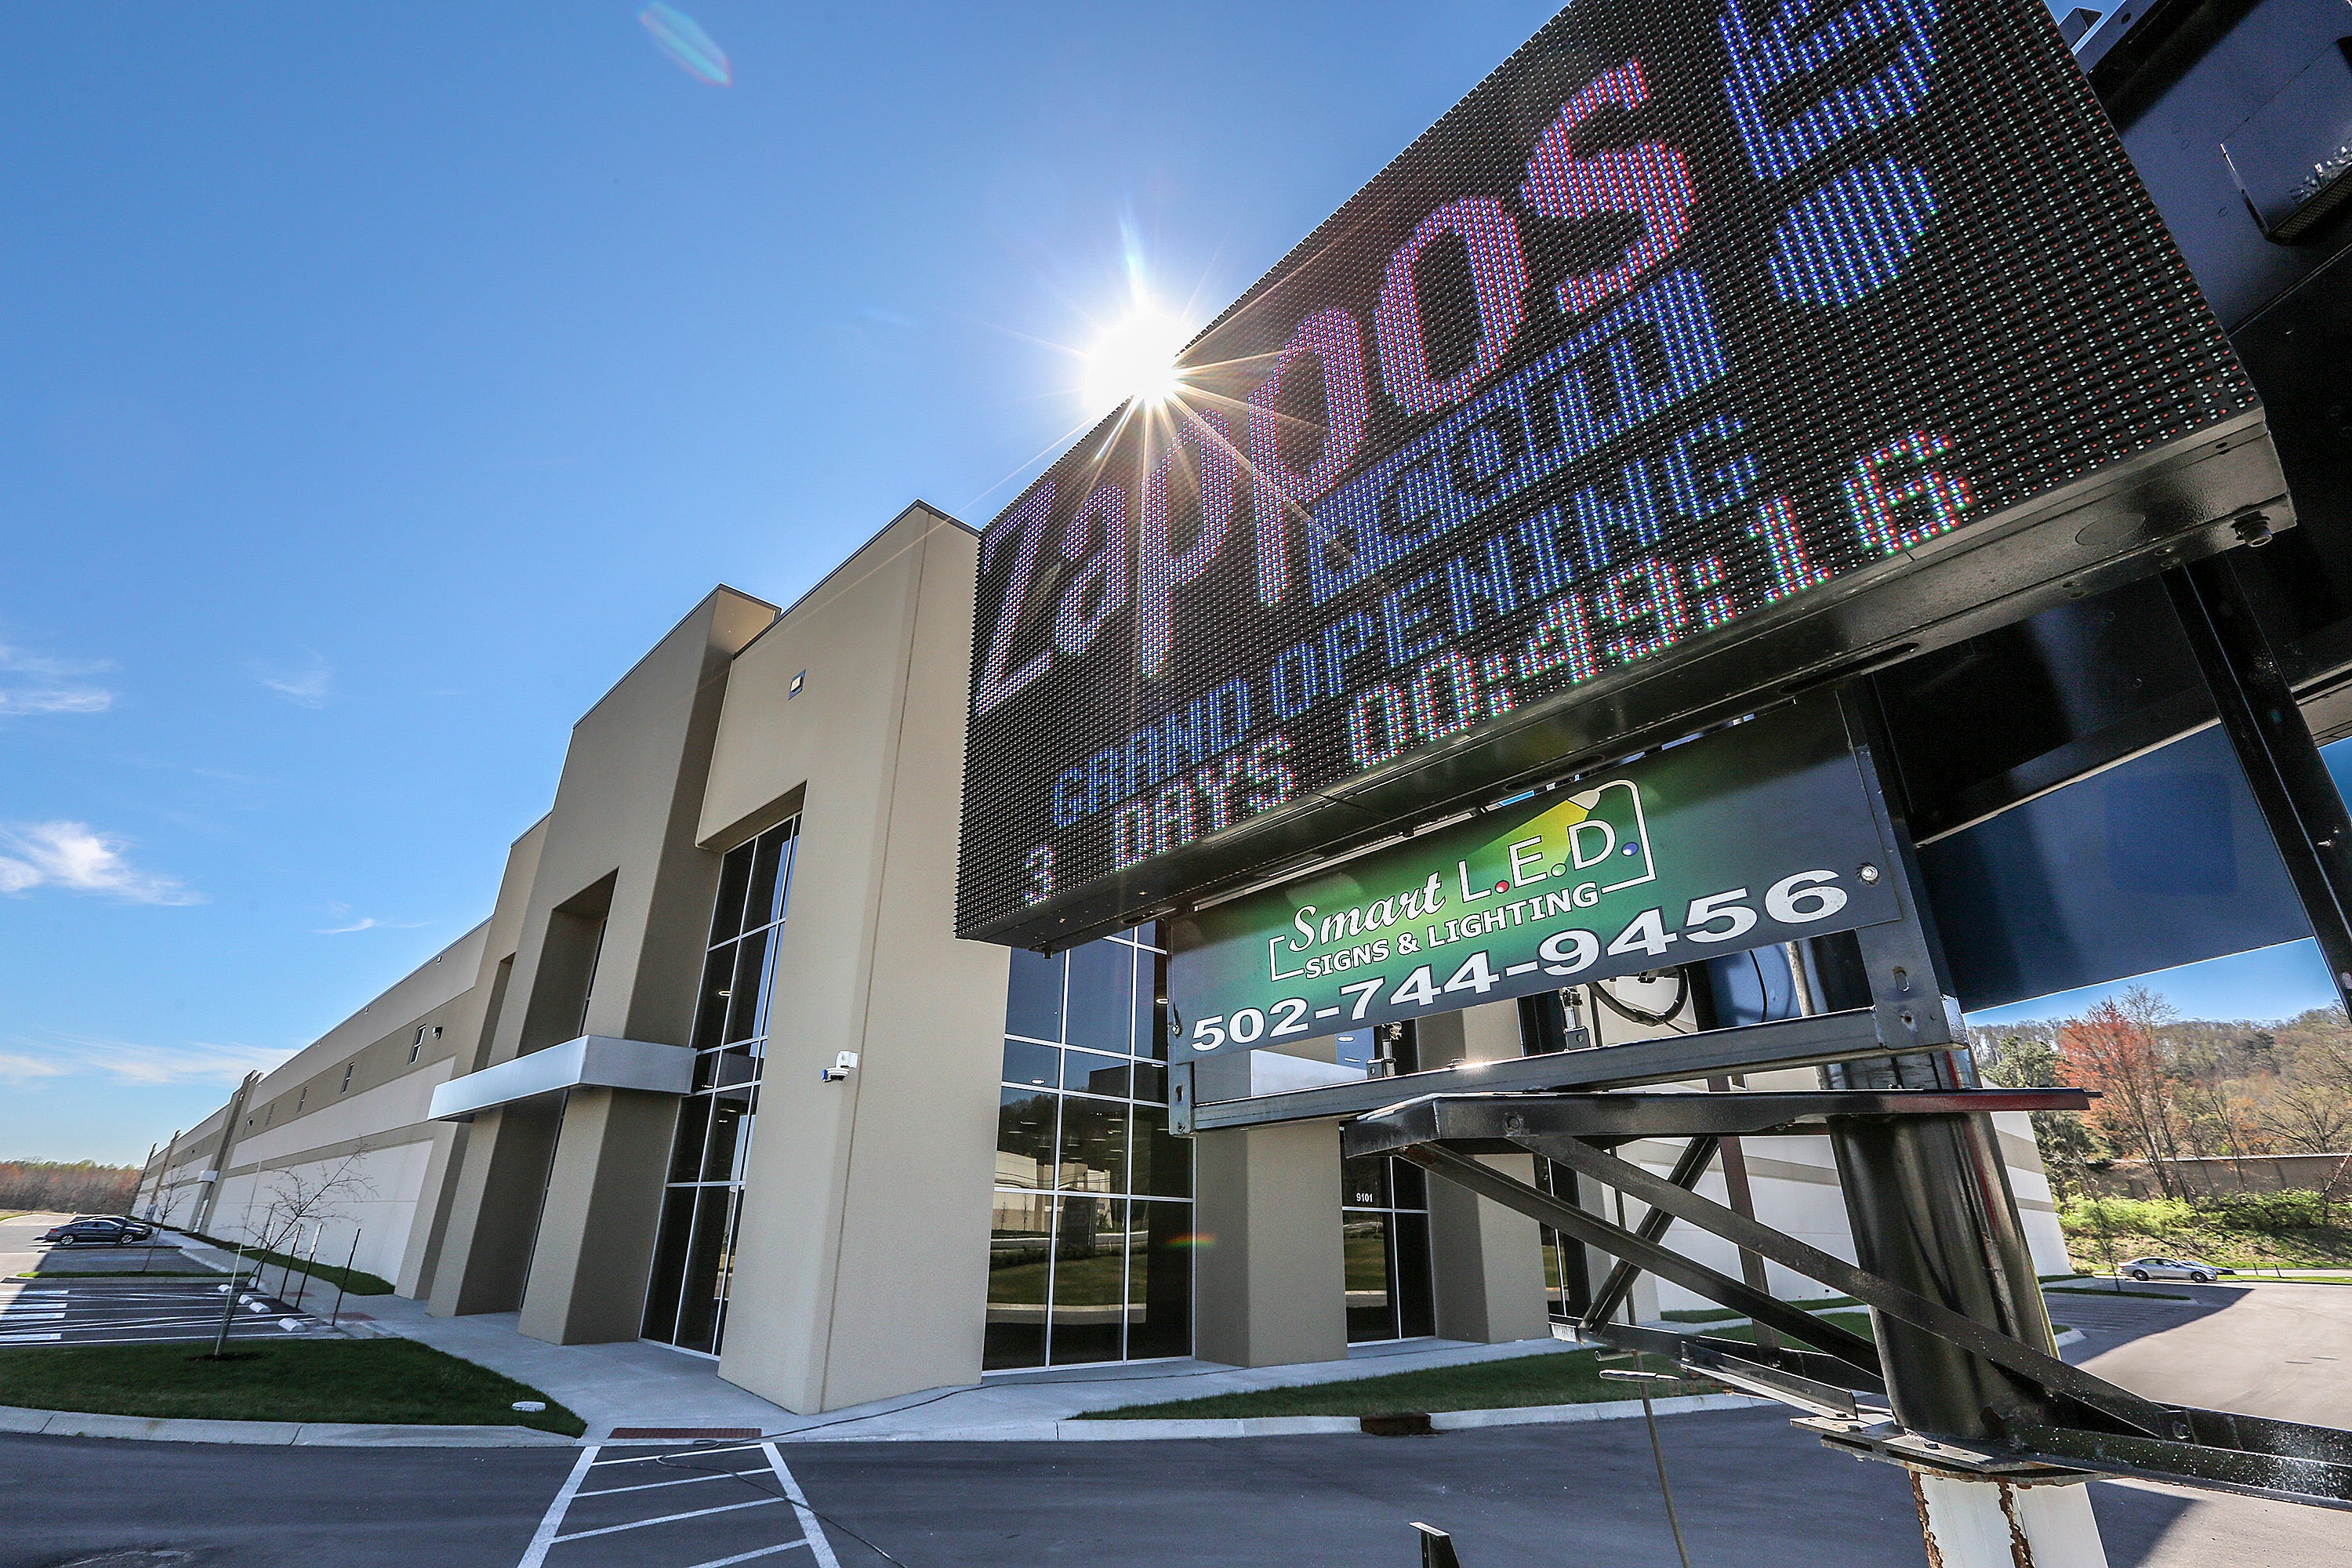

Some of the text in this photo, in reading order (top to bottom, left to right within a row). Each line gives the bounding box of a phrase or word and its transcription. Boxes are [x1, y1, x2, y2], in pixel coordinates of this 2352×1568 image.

[975, 59, 1697, 717] Zappos
[1053, 415, 1760, 829] GRAND OPENING
[1024, 845, 1054, 906] 3
[1113, 735, 1294, 872] DAYS
[1288, 819, 1639, 953] Smart L.E.D.
[1191, 869, 1849, 1052] 502-744-9456
[1305, 881, 1600, 980] SIGNS & LIGHTING
[1356, 1192, 1373, 1203] 9101
